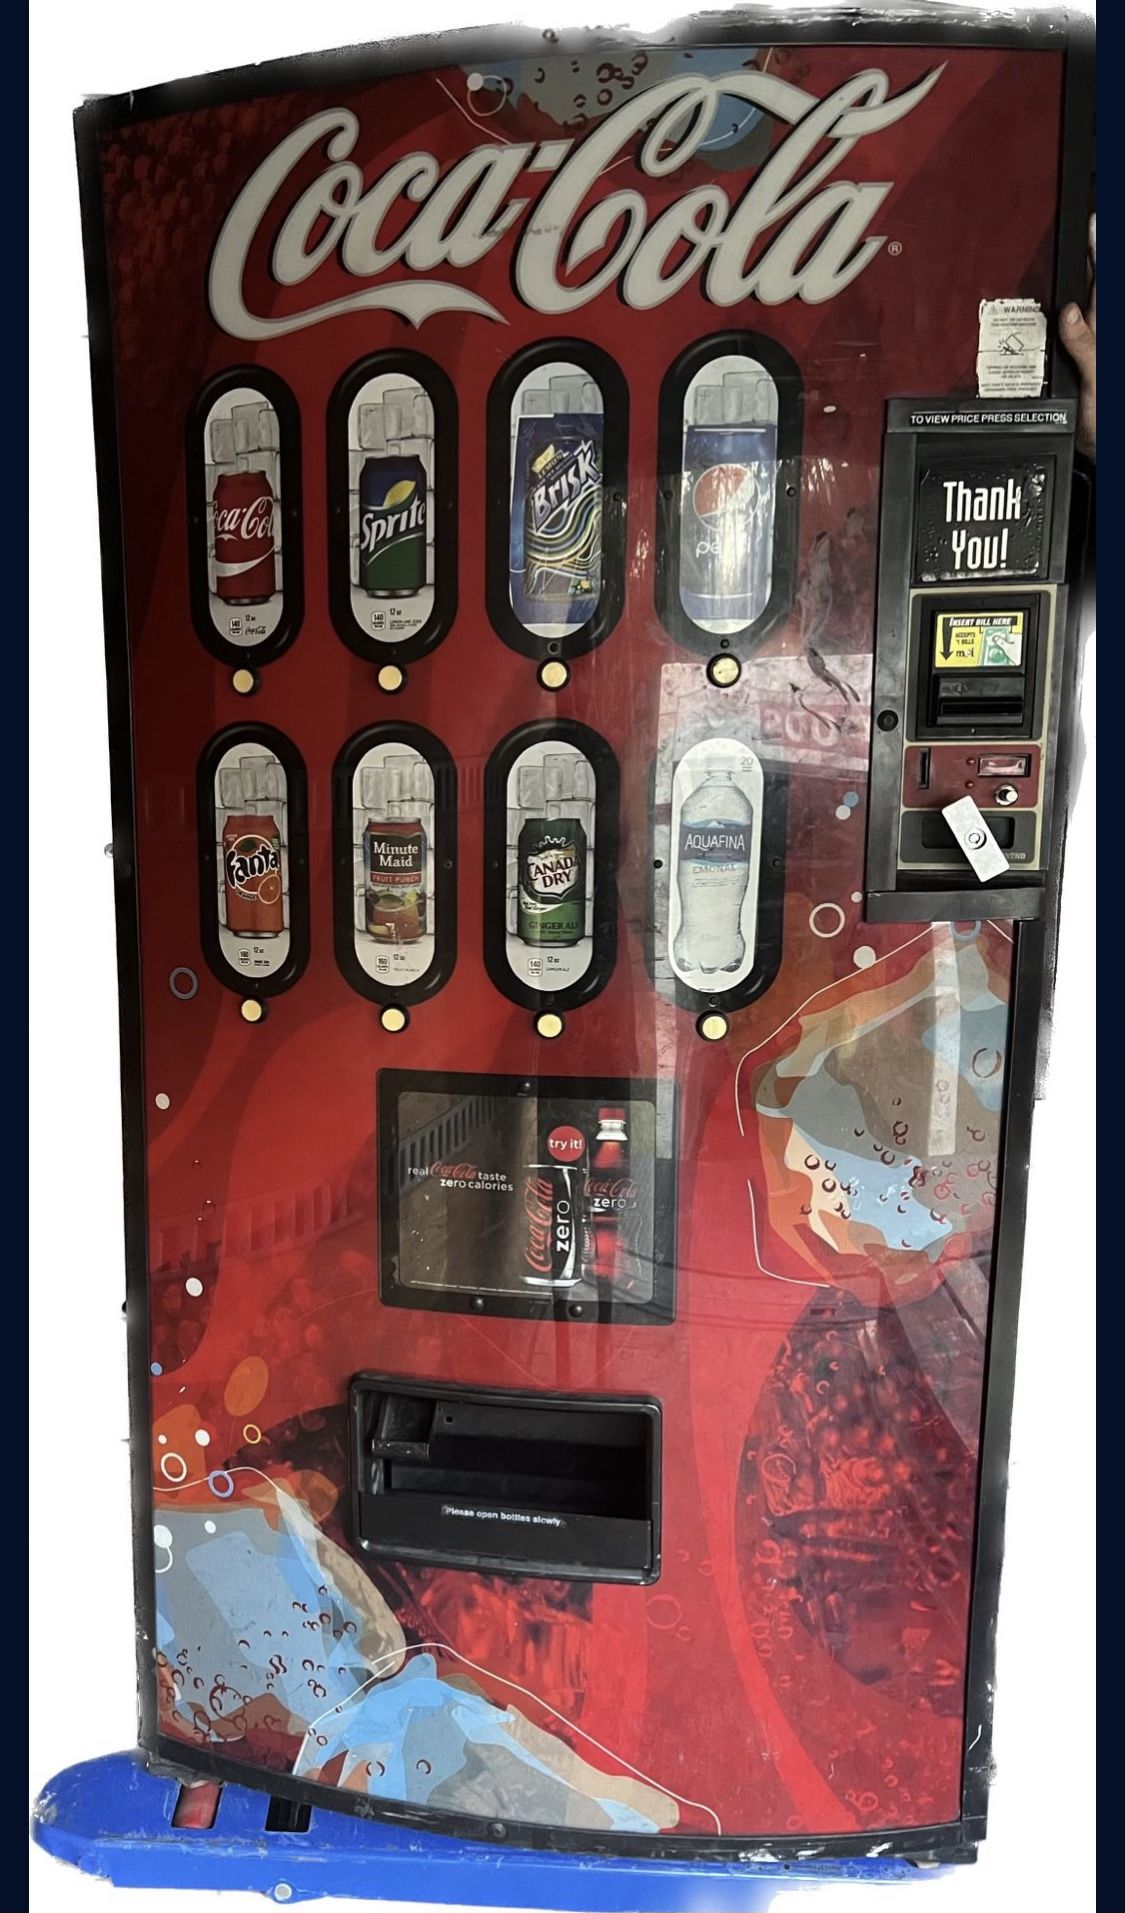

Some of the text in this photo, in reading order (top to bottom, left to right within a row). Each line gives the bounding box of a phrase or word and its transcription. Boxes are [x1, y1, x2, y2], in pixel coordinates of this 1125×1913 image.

[207, 60, 948, 341] Coca-Cola
[910, 412, 1067, 425] TO VIEW PRICE PRESS SELECTION
[943, 478, 1021, 523] Thank
[360, 493, 426, 553] Sprite
[952, 528, 1008, 570] You!
[373, 841, 419, 855] Minute
[684, 833, 746, 852] AQUAFINA
[226, 844, 279, 889] Fanta
[379, 854, 413, 867] Maid
[527, 857, 578, 882] CANAD
[542, 870, 571, 889] DRY
[549, 1139, 583, 1151] try it!
[408, 1166, 429, 1176] real
[478, 1171, 507, 1181] taste
[440, 1178, 513, 1192] zero calories
[593, 1198, 626, 1209] zero
[556, 1200, 570, 1252] zero
[446, 1506, 561, 1527] Please open bottles slowly
